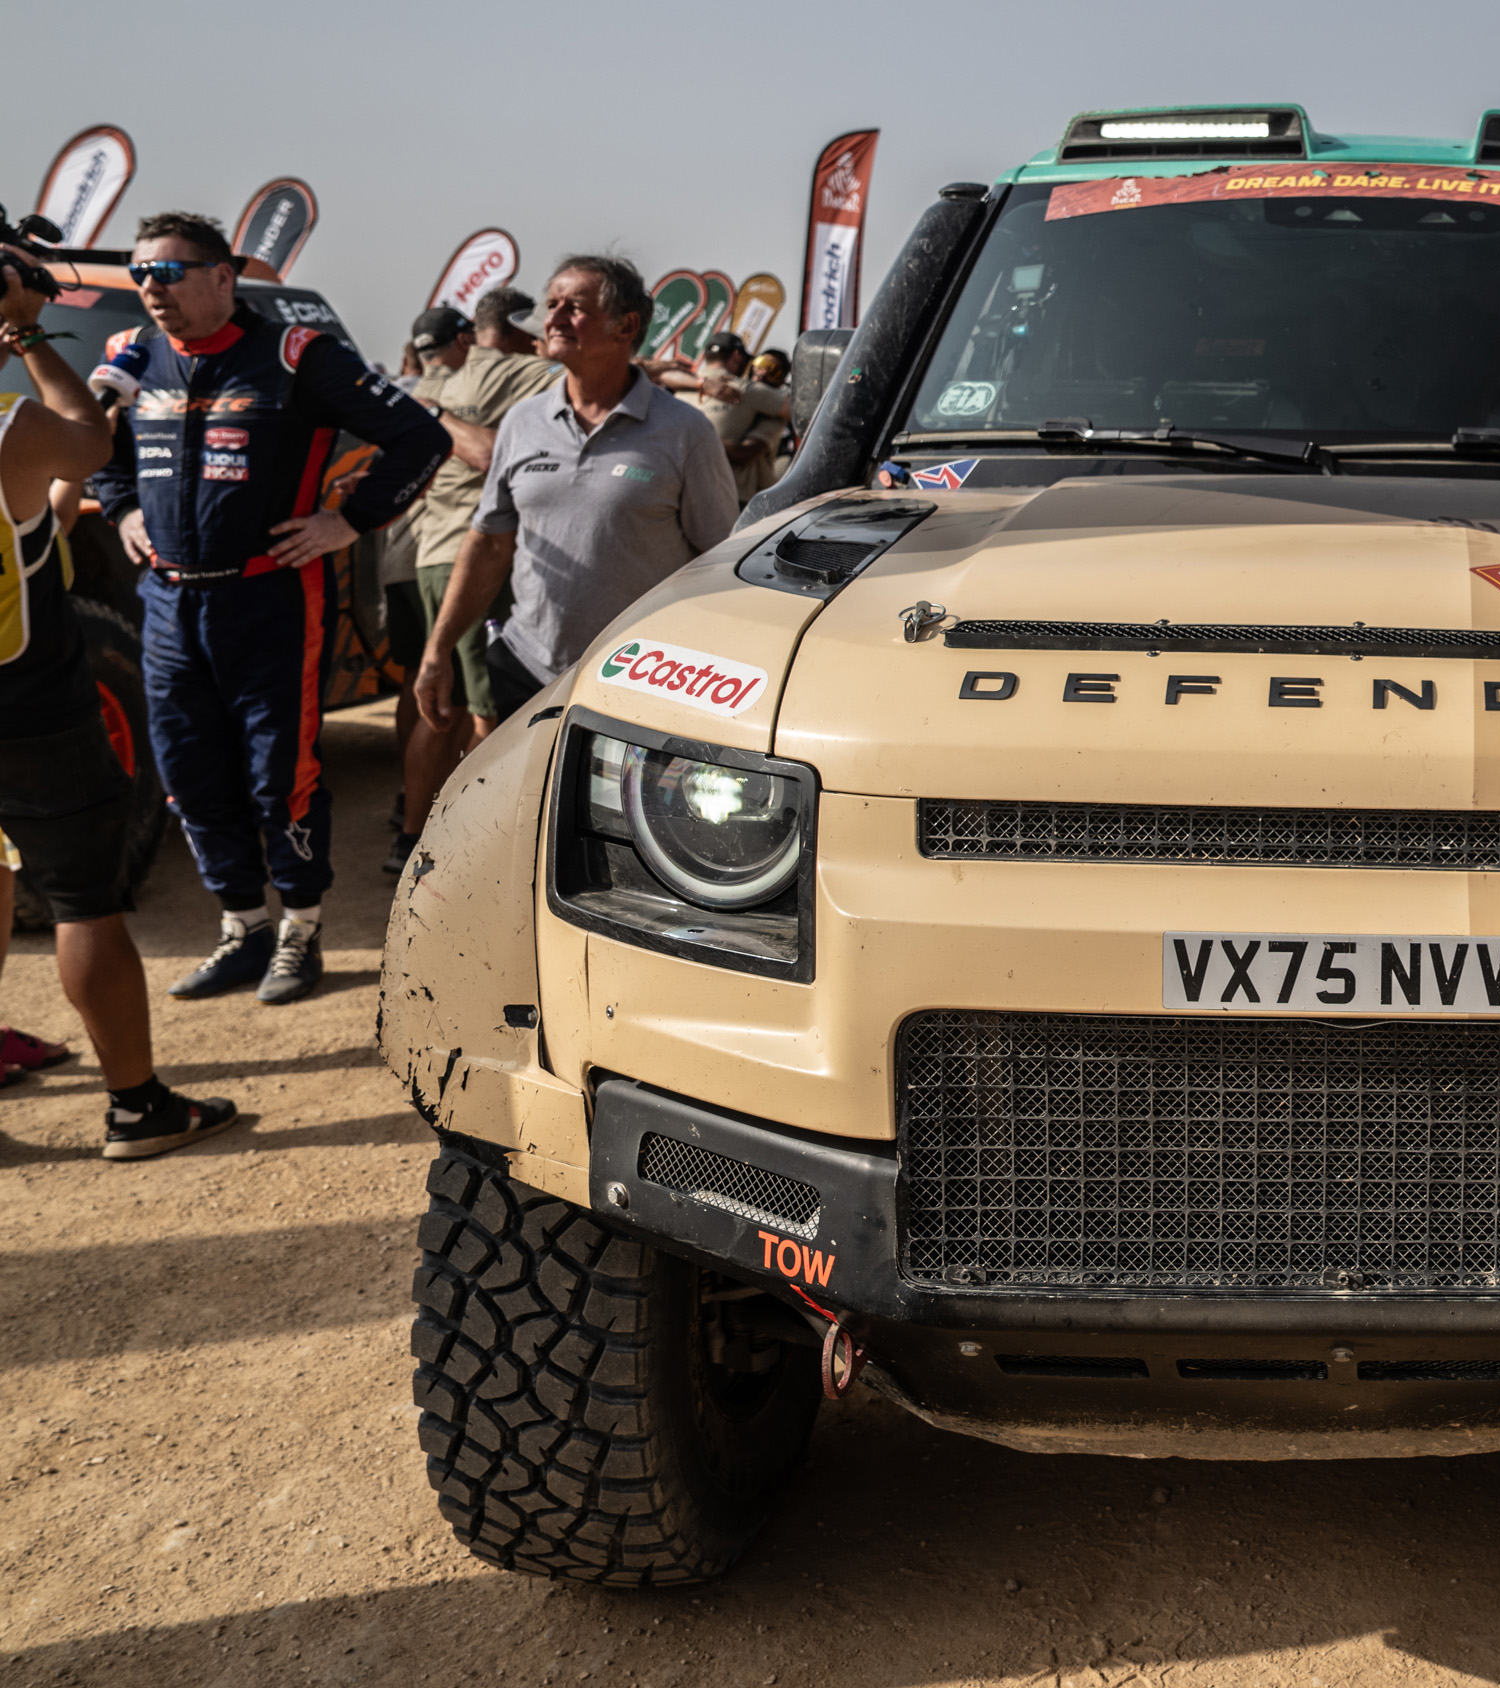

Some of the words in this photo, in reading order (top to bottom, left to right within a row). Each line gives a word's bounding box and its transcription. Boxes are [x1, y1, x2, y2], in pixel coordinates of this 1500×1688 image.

[1225, 175, 1328, 190] DREAM.
[1332, 175, 1411, 189] DARE.
[1416, 178, 1473, 193] LIVE
[939, 385, 991, 411] FIA
[628, 650, 762, 709] Castrol
[1172, 938, 1358, 1005] VX75
[757, 1229, 836, 1288] TOW
